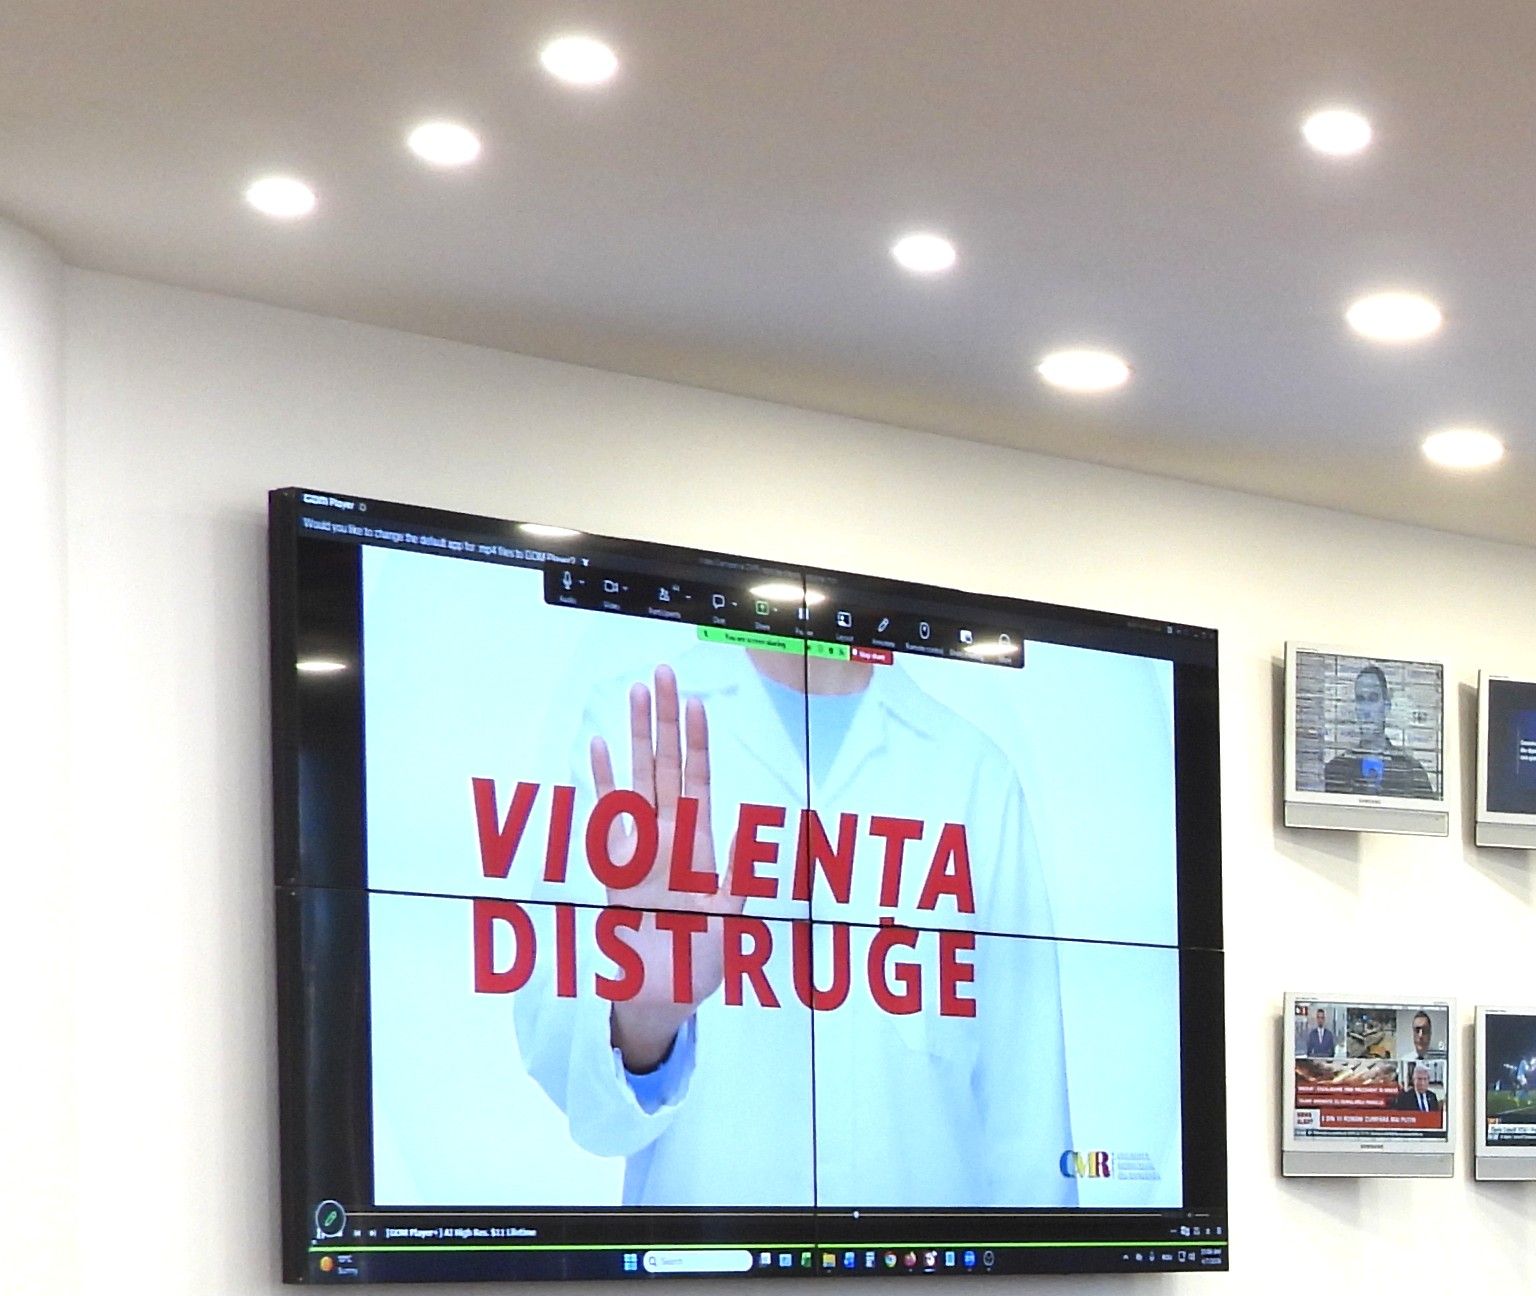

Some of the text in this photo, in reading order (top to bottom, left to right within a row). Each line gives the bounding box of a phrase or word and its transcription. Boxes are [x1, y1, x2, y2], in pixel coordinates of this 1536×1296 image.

[303, 517, 331, 531] Would
[332, 523, 347, 534] you
[374, 529, 404, 543] change
[472, 898, 978, 1018] DISTRUGE
